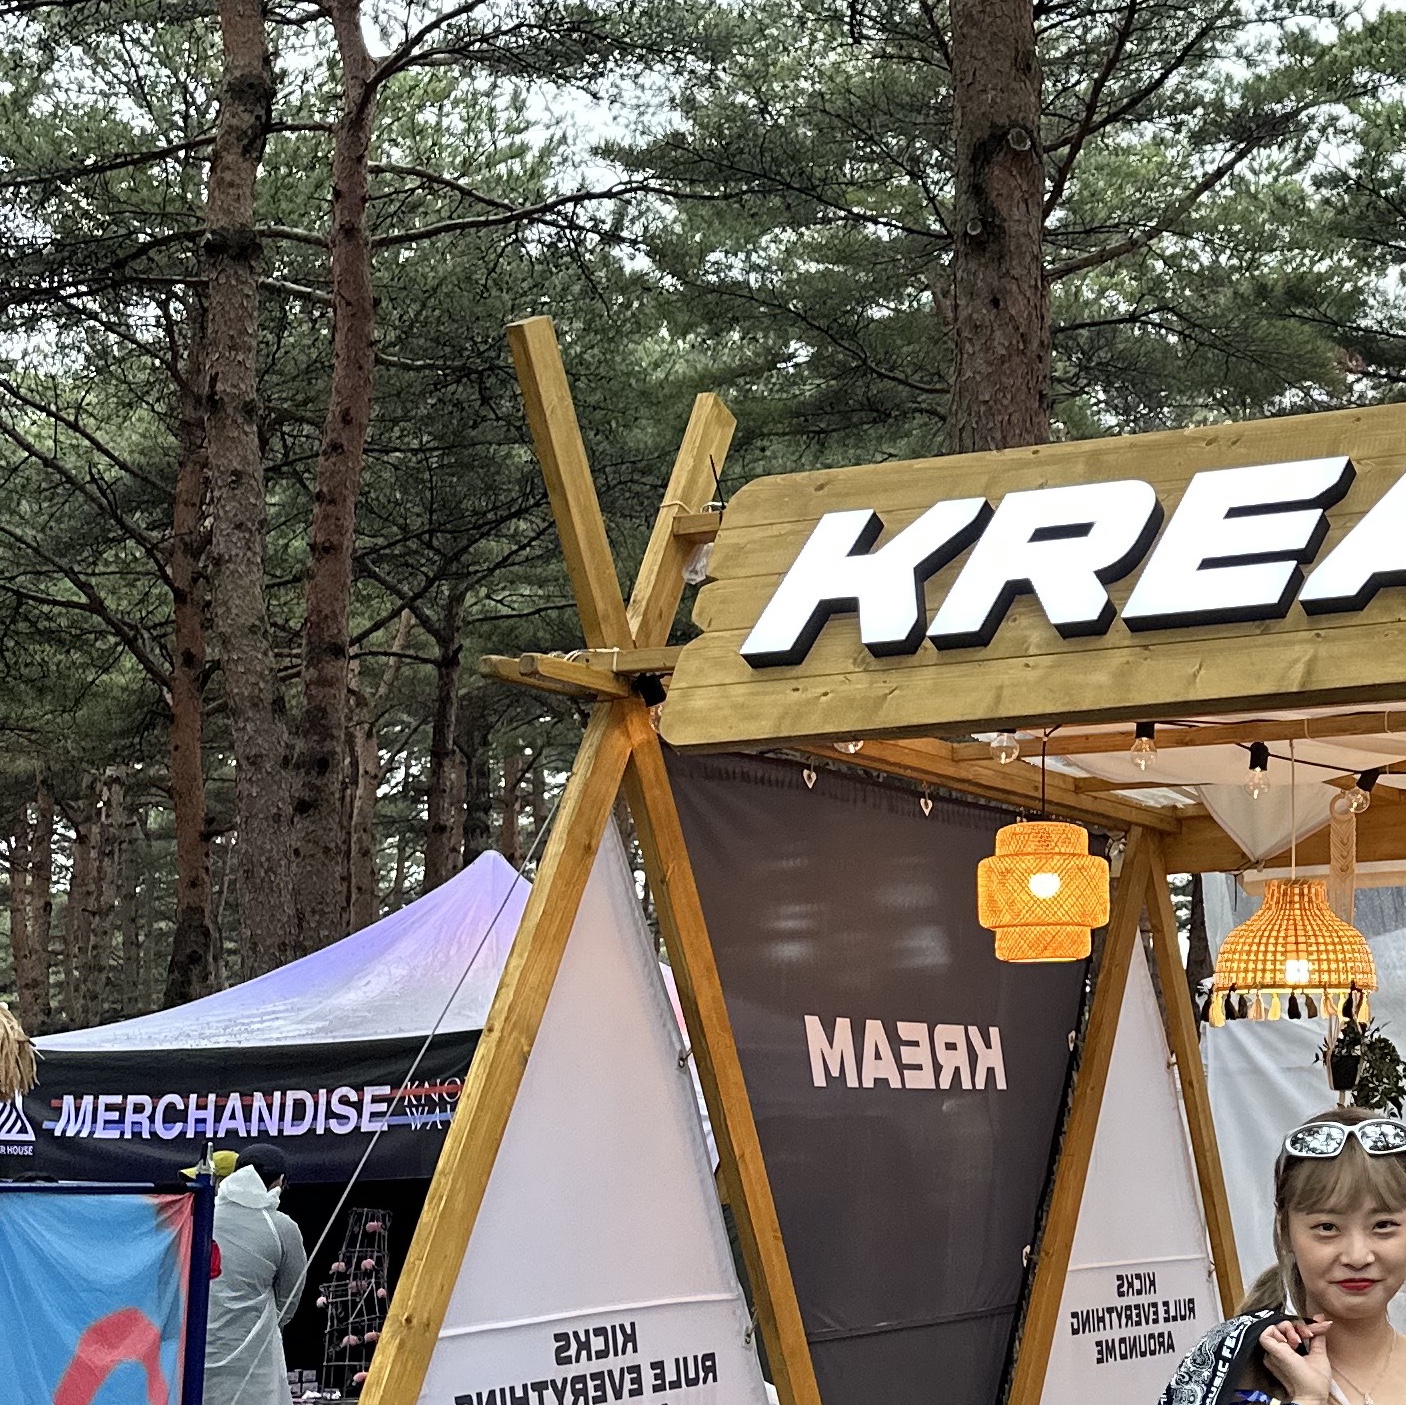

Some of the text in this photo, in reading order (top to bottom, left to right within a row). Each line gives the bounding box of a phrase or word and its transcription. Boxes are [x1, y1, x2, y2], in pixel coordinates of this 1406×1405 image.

[404, 1077, 466, 1105] KNO
[54, 1085, 391, 1140] MERCHANDISE
[7, 1145, 33, 1156] HOUSE
